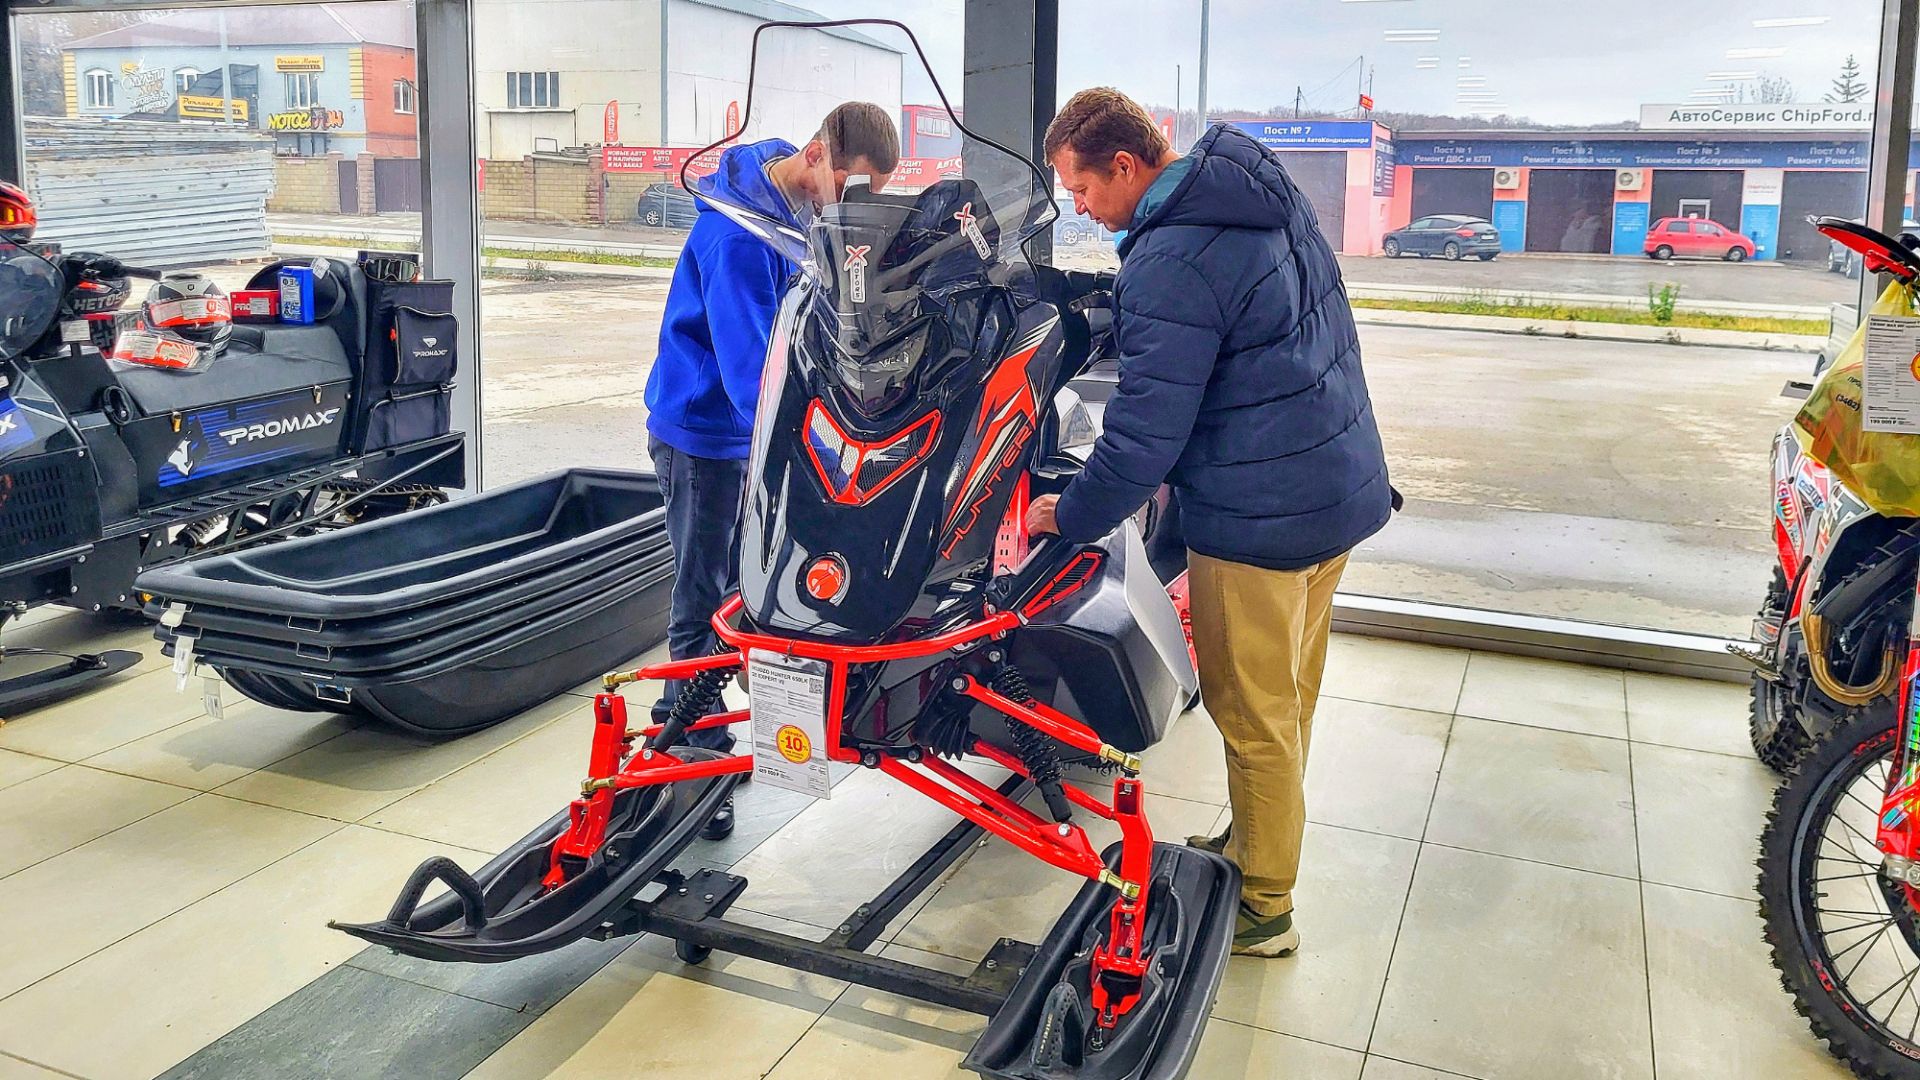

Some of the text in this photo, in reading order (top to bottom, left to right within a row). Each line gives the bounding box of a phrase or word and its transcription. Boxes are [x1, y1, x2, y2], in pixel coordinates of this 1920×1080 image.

[1669, 109, 1875, 124] АвтоСервис ChipFord.r
[1264, 126, 1312, 135] Пост № 7
[1433, 146, 1454, 154] Пост
[1552, 147, 1574, 155] Пост
[1587, 147, 1593, 155] 2
[1677, 147, 1699, 155] Пост
[1810, 147, 1834, 155] Пост
[1523, 156, 1555, 164] Ремонт
[1787, 156, 1822, 165] Ремонт
[412, 349, 448, 358] PROMAX
[218, 407, 341, 446] PROMAX
[941, 424, 1033, 560] HUNTER
[1777, 479, 1794, 528] KENDA
[1889, 1040, 1920, 1060] POWE
